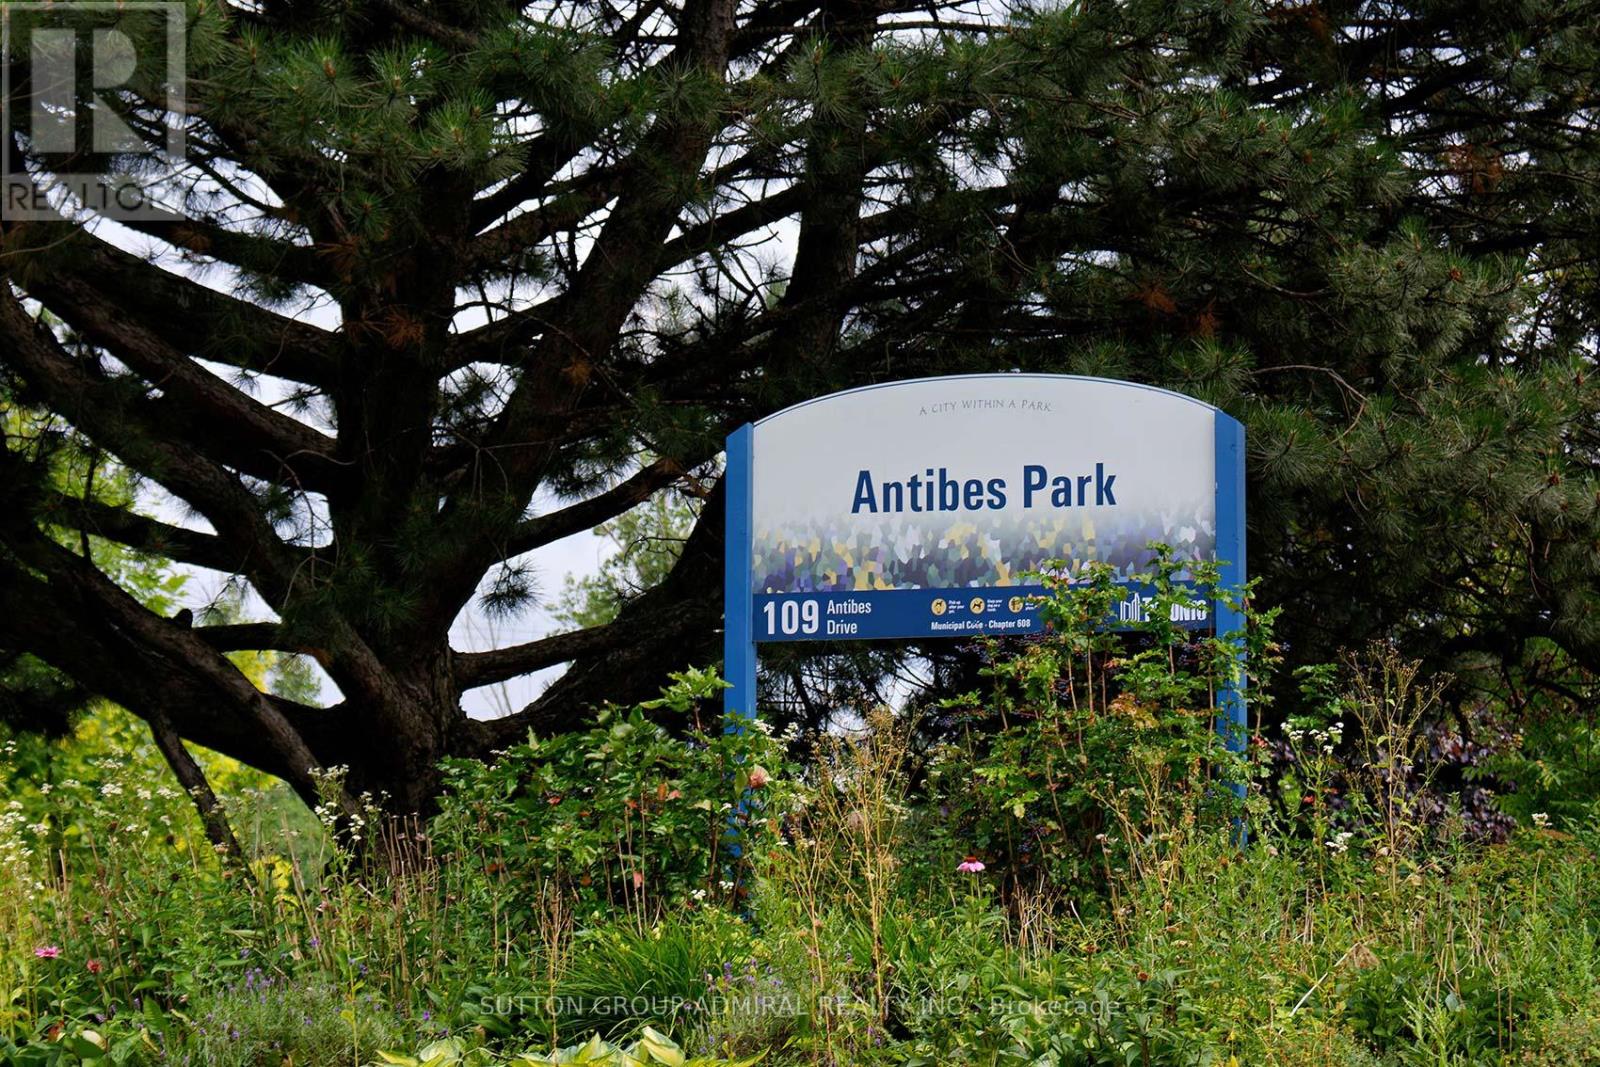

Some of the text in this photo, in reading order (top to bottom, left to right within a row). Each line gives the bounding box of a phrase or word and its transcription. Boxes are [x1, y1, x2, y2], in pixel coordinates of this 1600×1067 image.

[919, 399, 1052, 416] A CITY WITHIN A PARK
[851, 462, 1117, 514] Antibes Park
[826, 599, 872, 615] Antibes
[763, 599, 819, 635] 109
[931, 621, 965, 632] Municipal
[988, 619, 1015, 630] Chapter
[1016, 618, 1031, 628] 608
[826, 620, 858, 635] Drive
